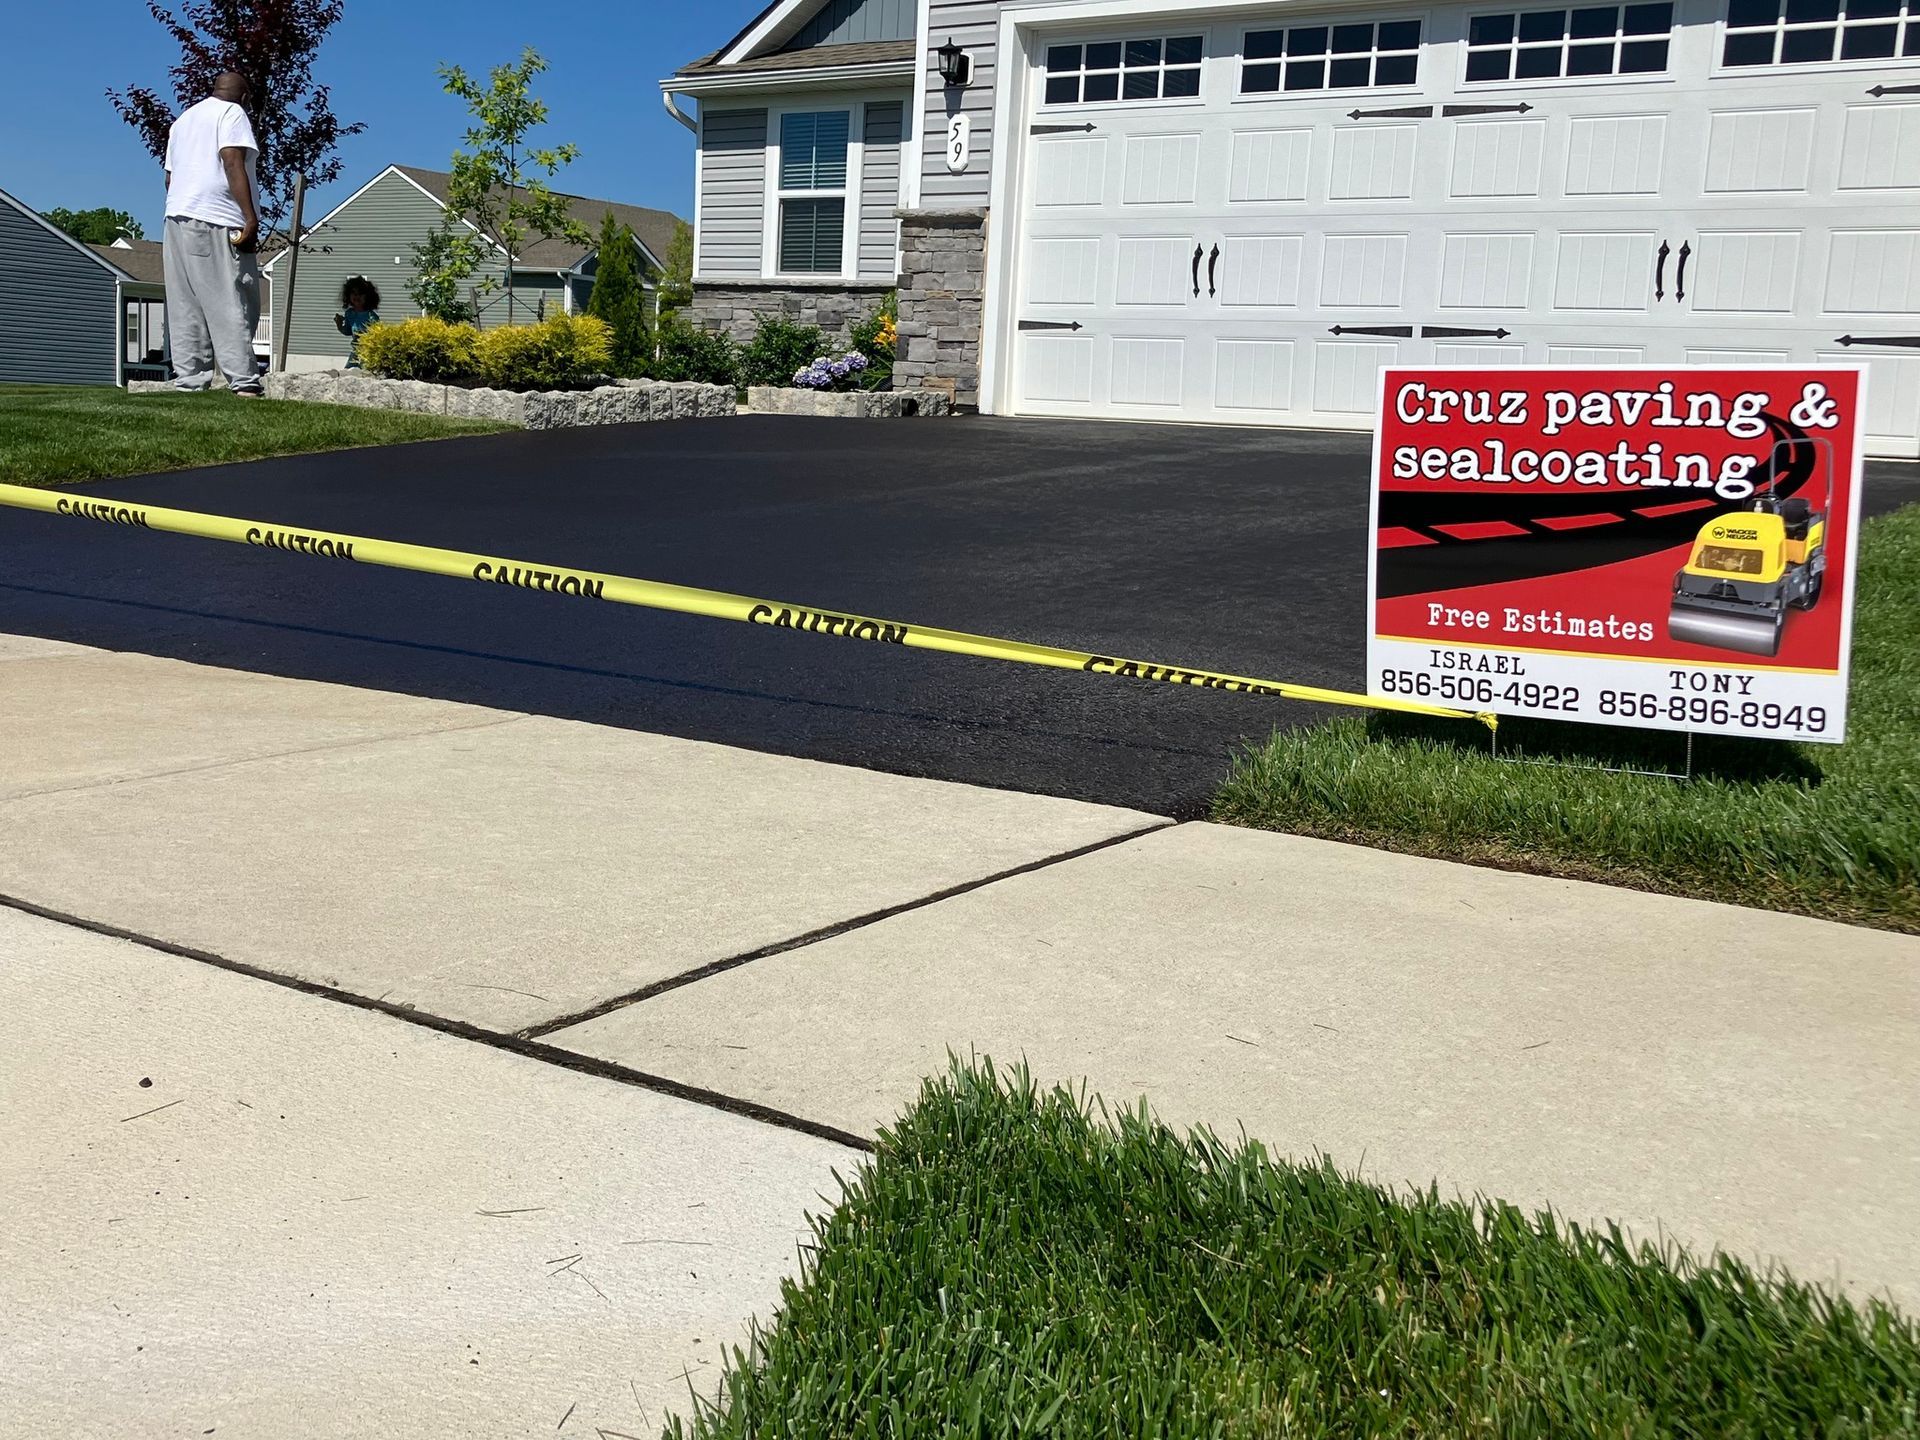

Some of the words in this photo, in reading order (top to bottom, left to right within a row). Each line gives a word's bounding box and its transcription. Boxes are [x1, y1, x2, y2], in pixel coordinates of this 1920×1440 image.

[1395, 382, 1528, 426] Cruz
[1542, 382, 1769, 438] paving
[1789, 382, 1838, 429] &
[1392, 439, 1756, 500] sealcoating
[1726, 528, 1757, 536] WACKER
[1726, 533, 1757, 541] NEUSON
[1427, 602, 1490, 629] Free
[1502, 608, 1654, 642] Estimates
[1429, 650, 1526, 676] ISRAEL
[1381, 669, 1580, 712] 856-506-4922
[1669, 671, 1756, 696] TONY
[1599, 689, 1826, 733] 856-896-8949
